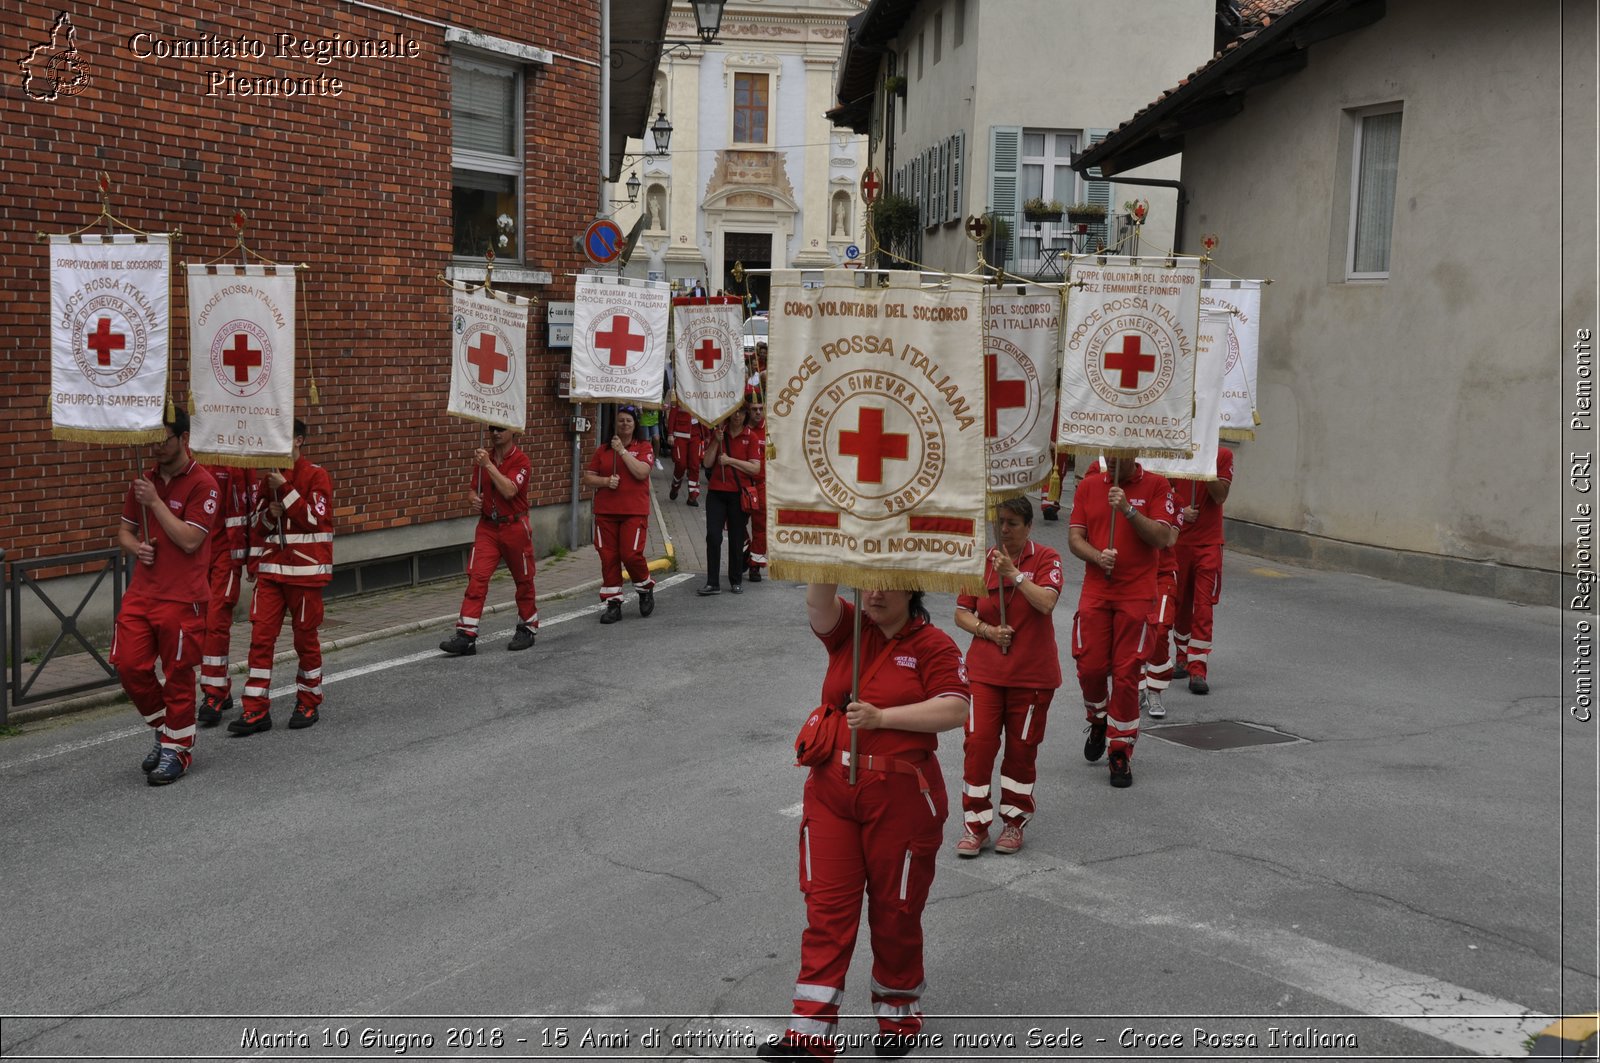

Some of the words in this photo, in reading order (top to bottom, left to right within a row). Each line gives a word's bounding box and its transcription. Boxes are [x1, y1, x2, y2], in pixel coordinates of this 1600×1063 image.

[57, 258, 78, 268] CORPO
[111, 261, 124, 270] DEL
[127, 260, 162, 270] SOCCORSO
[1103, 271, 1141, 282] VOLONTARI
[1144, 273, 1156, 283] DEL
[1160, 274, 1195, 285] SOCCORSO
[581, 287, 597, 295] CORPO
[600, 288, 627, 296] VOLONTARI
[628, 291, 637, 299] DEL
[1149, 286, 1180, 296] PIONIERI
[62, 289, 84, 330] CROCE
[84, 277, 119, 295] ROSSA
[123, 282, 159, 331] ITALIANA
[198, 293, 222, 327] CROCE
[222, 284, 254, 298] ROSSA
[255, 289, 286, 330] ITALIANA
[576, 295, 604, 304] CROCE
[606, 298, 632, 306] ROSSA
[634, 300, 668, 309] ITALIANA
[990, 305, 1007, 315] DEL
[1011, 303, 1051, 316] SOCCORSO
[453, 305, 473, 317] CROCE
[475, 310, 498, 323] ROSSA
[499, 317, 526, 329] ITALIANA
[493, 306, 501, 316] DEL
[818, 301, 878, 318] VOLONTARI
[885, 303, 907, 318] DEL
[913, 305, 968, 322] SOCCORSO
[80, 310, 89, 320] DI
[89, 297, 125, 311] GINEVRA
[125, 308, 137, 320] 22
[134, 323, 145, 364] AGOSTO
[230, 321, 257, 333] GINEVRA
[256, 329, 266, 340] 22
[677, 324, 691, 349] CROCE
[691, 315, 716, 328] ROSSA
[717, 319, 741, 349] ITALIANA
[1003, 317, 1058, 330] ITALIANA
[1068, 309, 1102, 351] CROCE
[1103, 297, 1149, 315] ROSSA
[1151, 302, 1191, 357] ITALIANA
[1103, 326, 1113, 337] DI
[1117, 318, 1159, 337] GINEVRA
[1157, 337, 1170, 349] 22
[992, 338, 1001, 348] DI
[1004, 344, 1037, 381] GINEVRA
[1087, 337, 1119, 403] CONVENZIONE
[1157, 352, 1173, 389] AGOSTO
[586, 375, 638, 386] DELEGAZIONE
[773, 354, 822, 418] CROCE
[821, 334, 895, 363] ROSSA
[900, 343, 975, 432] ITALIANA
[460, 391, 485, 404] COMITATO
[588, 384, 646, 395] PEVERAGNO
[685, 391, 736, 400] SAVIGLIANO
[827, 385, 846, 404] DI
[848, 374, 918, 406] GINEVRA
[1137, 387, 1160, 404] 1864
[57, 393, 94, 405] GRUPPO
[97, 394, 105, 405] DI
[107, 395, 162, 407] SAMPEYRE
[203, 404, 247, 414] COMITATO
[248, 406, 280, 417] LOCALE
[465, 400, 509, 418] MORETTA
[916, 406, 934, 426] 22
[237, 420, 247, 430] DI
[1070, 411, 1123, 423] COMITATO
[1127, 415, 1168, 425] LOCALE
[1171, 417, 1180, 426] DI
[1063, 423, 1104, 435] BORGO
[1109, 427, 1119, 437] S.
[1124, 427, 1187, 440] DALMAZZO
[217, 434, 264, 447] BUSCA
[807, 405, 856, 510] CONVENZIONE
[917, 431, 941, 488] AGOSTO
[883, 486, 922, 513] 1864
[775, 529, 858, 551] COMITATO
[863, 539, 881, 553] DI
